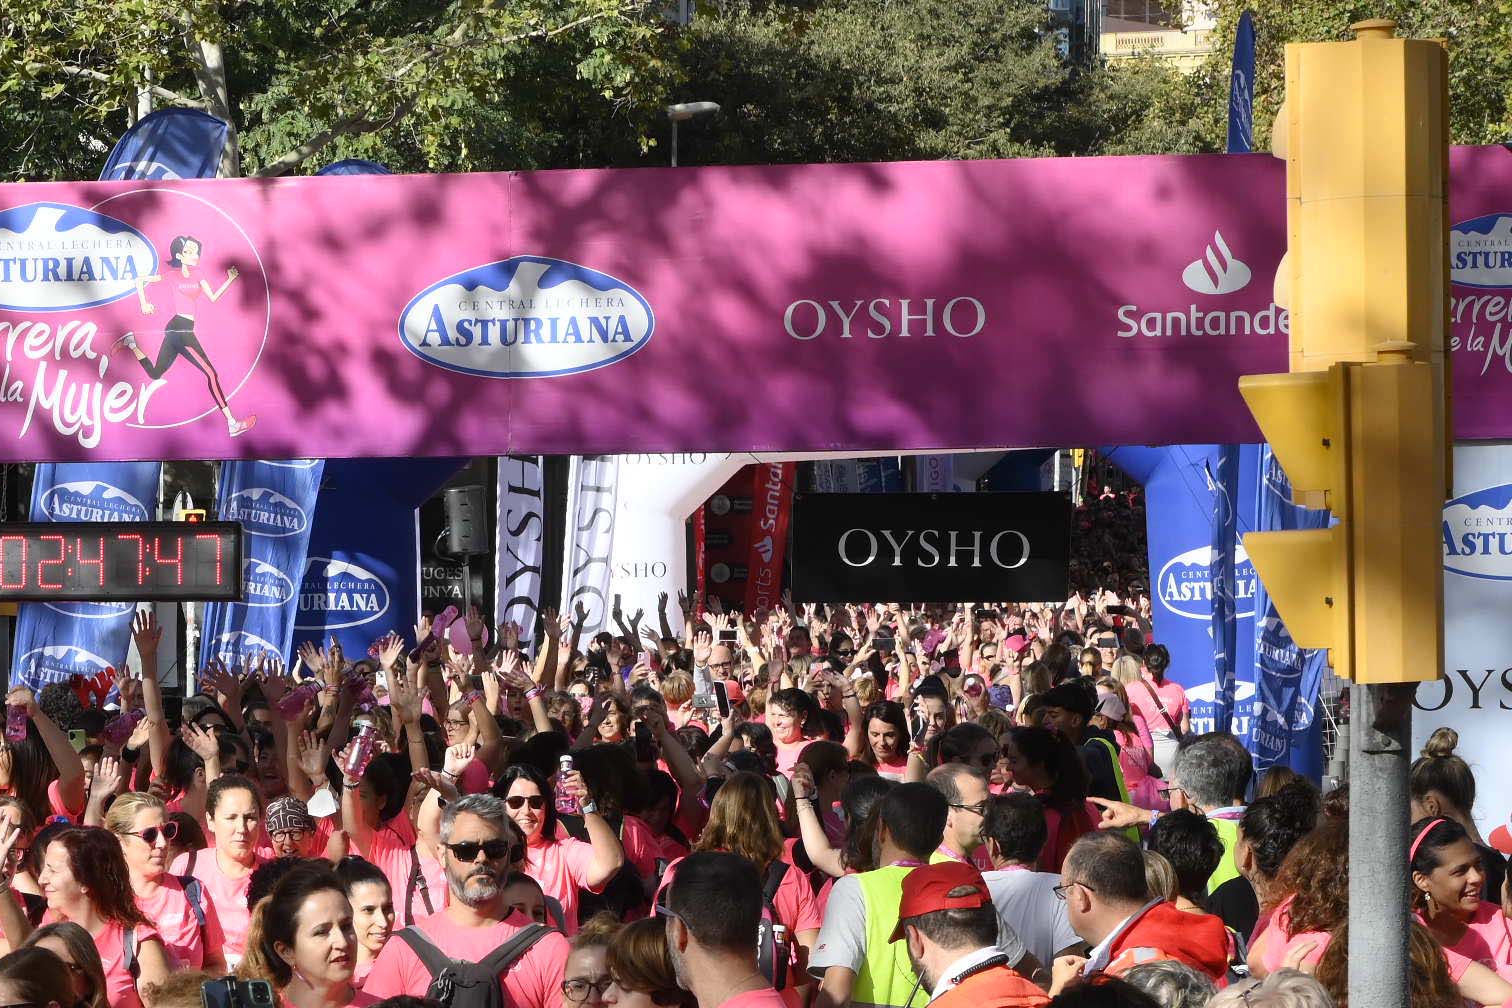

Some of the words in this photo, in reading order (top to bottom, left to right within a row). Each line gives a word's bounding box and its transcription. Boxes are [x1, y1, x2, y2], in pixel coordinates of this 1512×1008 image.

[458, 299, 537, 312] CENTRAL
[544, 297, 626, 309] LECHERA
[783, 296, 986, 341] OYSHO
[1117, 303, 1289, 338] Santande
[418, 303, 634, 348] ASTURIANA
[1467, 324, 1484, 352] la
[0, 362, 25, 403] la
[18, 355, 167, 449] Mujer
[48, 493, 140, 522] ASTURIANA
[228, 500, 299, 530] ASTURIANA
[1464, 517, 1512, 527] CENTR
[504, 455, 542, 652] OYSH
[569, 454, 614, 634] OYSH
[837, 528, 1031, 569] OYSHO
[0, 534, 221, 589] 02:47:47
[422, 567, 463, 580] UGES
[612, 560, 668, 578] YSHO
[327, 581, 376, 590] LECHERA
[299, 592, 380, 612] URIANA
[1412, 667, 1512, 712] OYS
